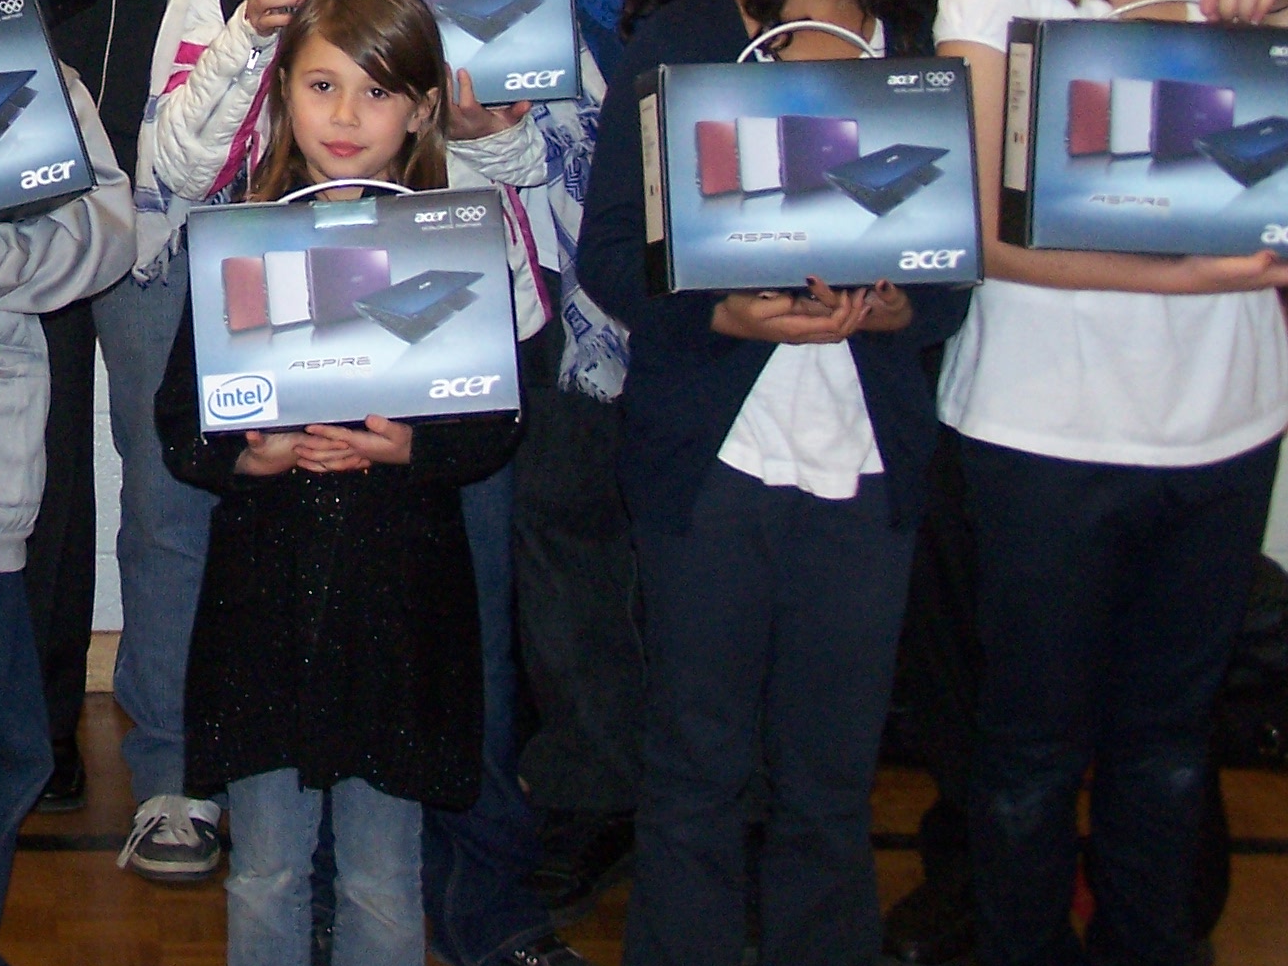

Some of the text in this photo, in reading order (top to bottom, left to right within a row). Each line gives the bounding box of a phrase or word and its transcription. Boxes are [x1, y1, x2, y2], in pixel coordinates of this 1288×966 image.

[504, 69, 565, 90] acer
[21, 160, 76, 190] acer
[1089, 195, 1171, 207] ASPIRE
[727, 232, 808, 242] ASPIRE
[899, 249, 966, 270] acer
[289, 356, 371, 370] ASPIRE
[216, 384, 262, 407] intel
[429, 374, 500, 398] acer
